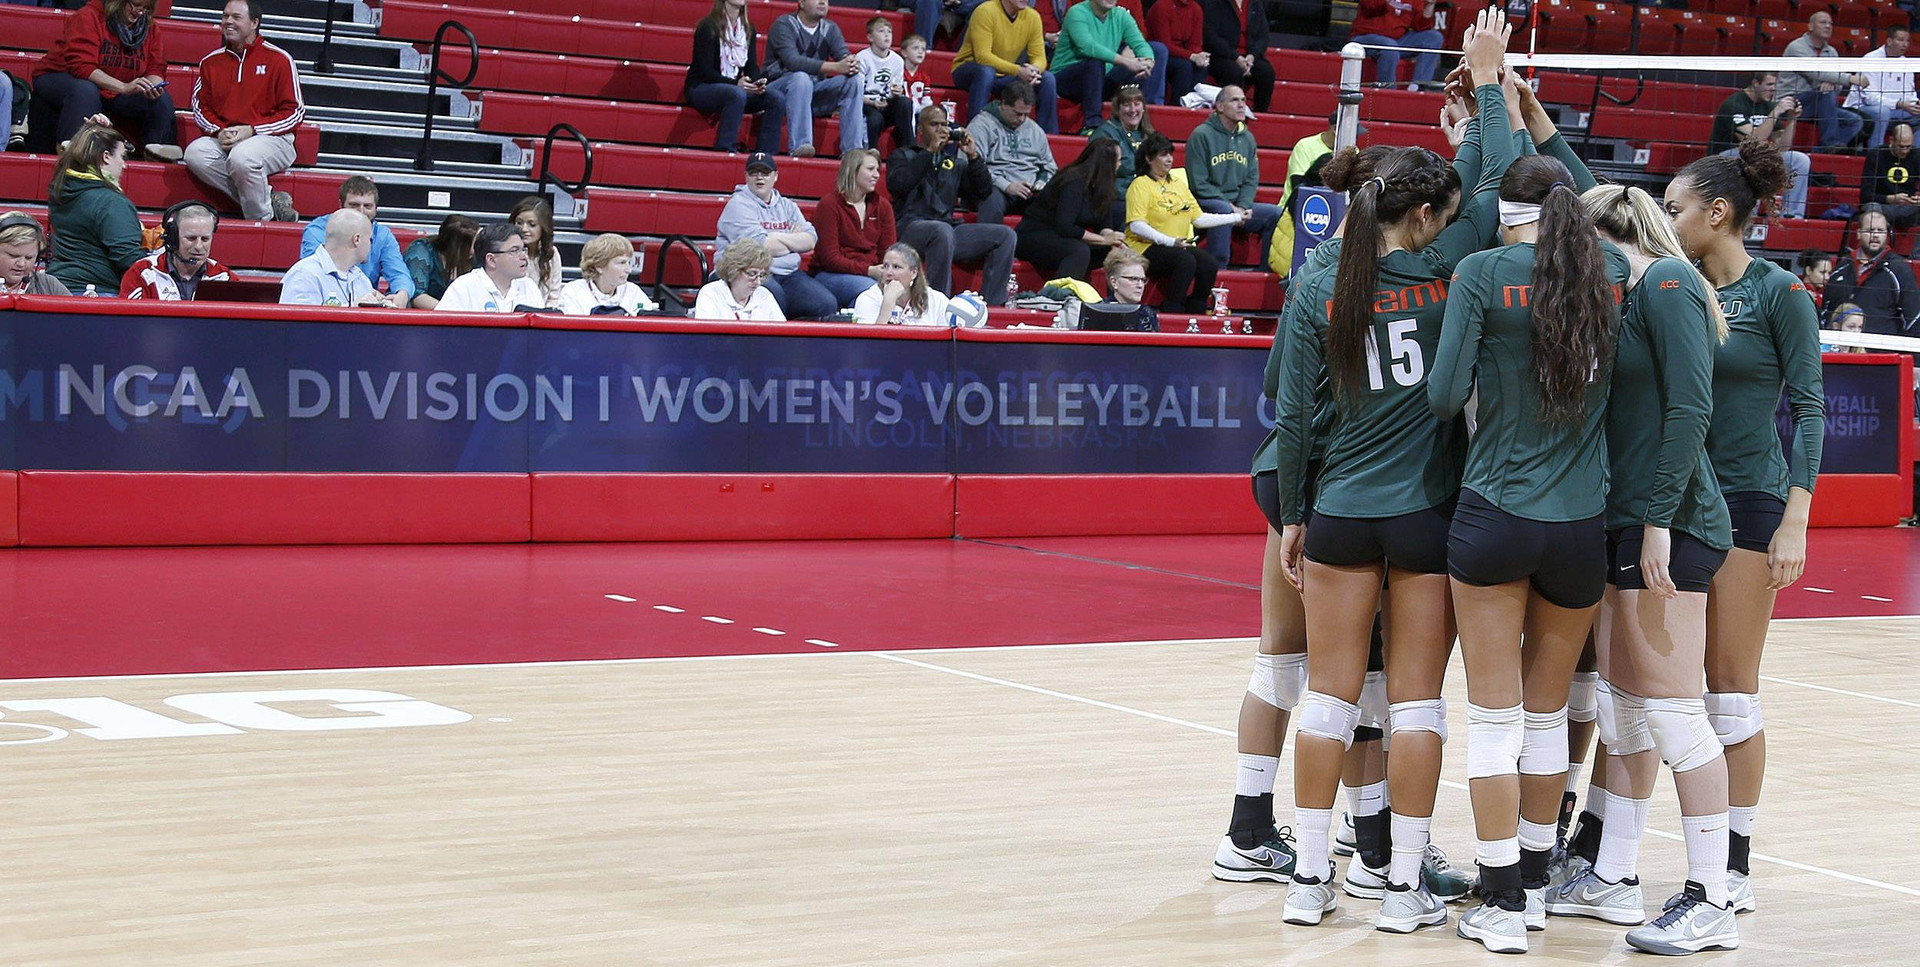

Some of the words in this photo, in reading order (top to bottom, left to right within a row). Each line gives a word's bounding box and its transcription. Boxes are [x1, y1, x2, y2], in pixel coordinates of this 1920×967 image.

[1434, 11, 1447, 30] N
[255, 65, 264, 75] N
[755, 152, 765, 161] T
[1888, 166, 1909, 184] O
[1305, 212, 1329, 227] NCAA
[1659, 278, 1680, 290] ACC
[1364, 317, 1425, 391] 15
[58, 363, 265, 418] NCAA
[287, 369, 573, 422] DIVISION
[599, 375, 610, 422] I
[631, 376, 904, 425] WOMEN'S
[921, 381, 1241, 428] VOLLEYBALL
